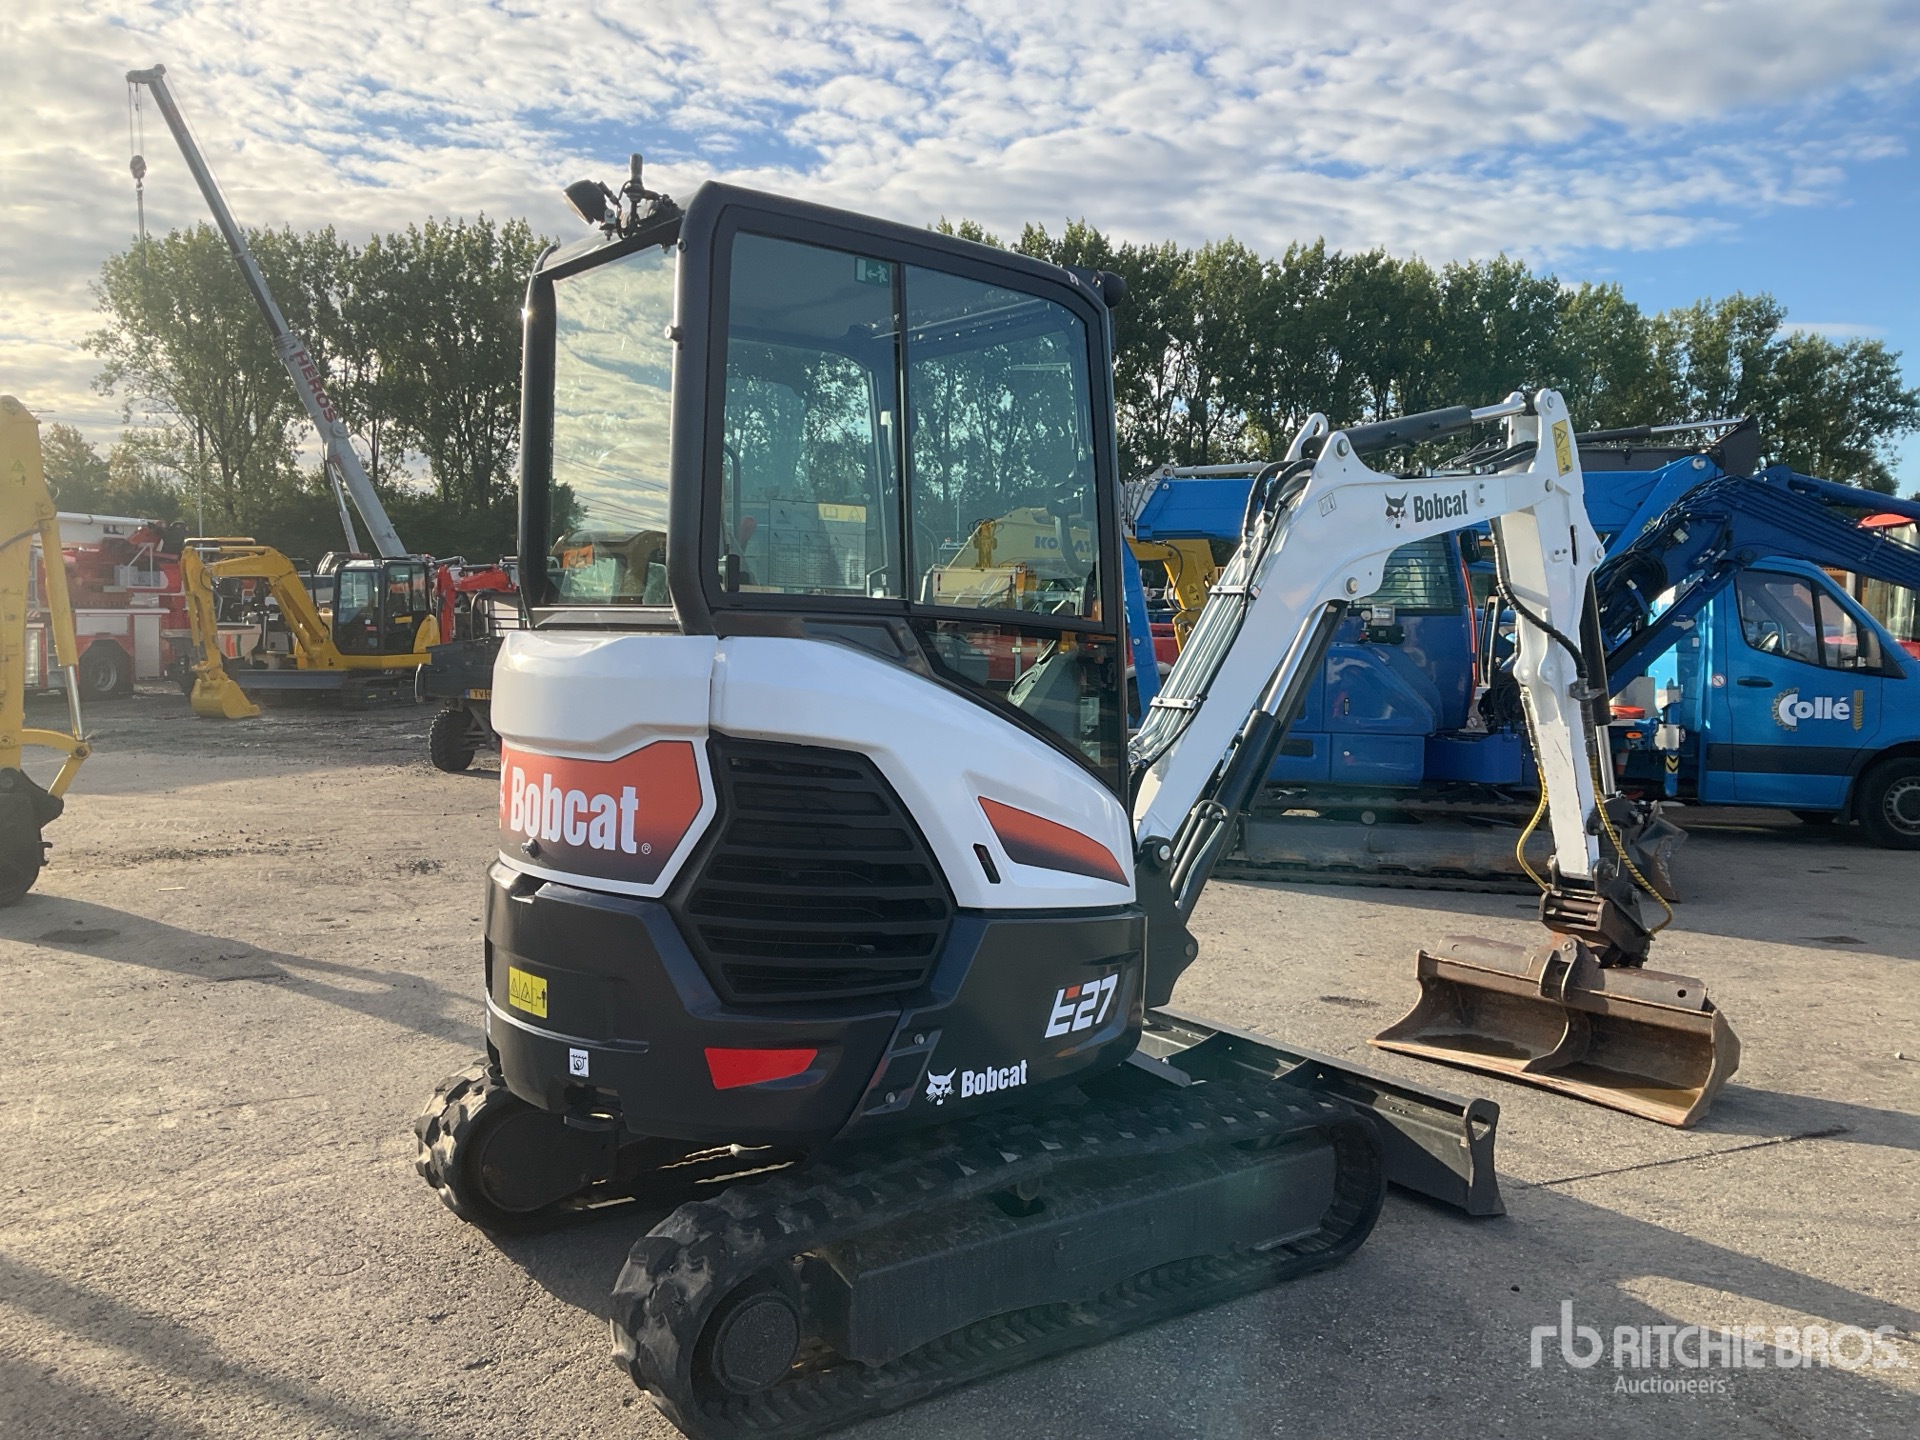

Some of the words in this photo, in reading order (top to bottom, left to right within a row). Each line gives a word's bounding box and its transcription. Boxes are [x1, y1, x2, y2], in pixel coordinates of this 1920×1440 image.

[294, 350, 337, 423] HEROS
[1413, 490, 1468, 523] Bobcat
[1778, 693, 1850, 726] Collé
[1044, 973, 1118, 1038] E27
[961, 1059, 1028, 1098] Bobcat
